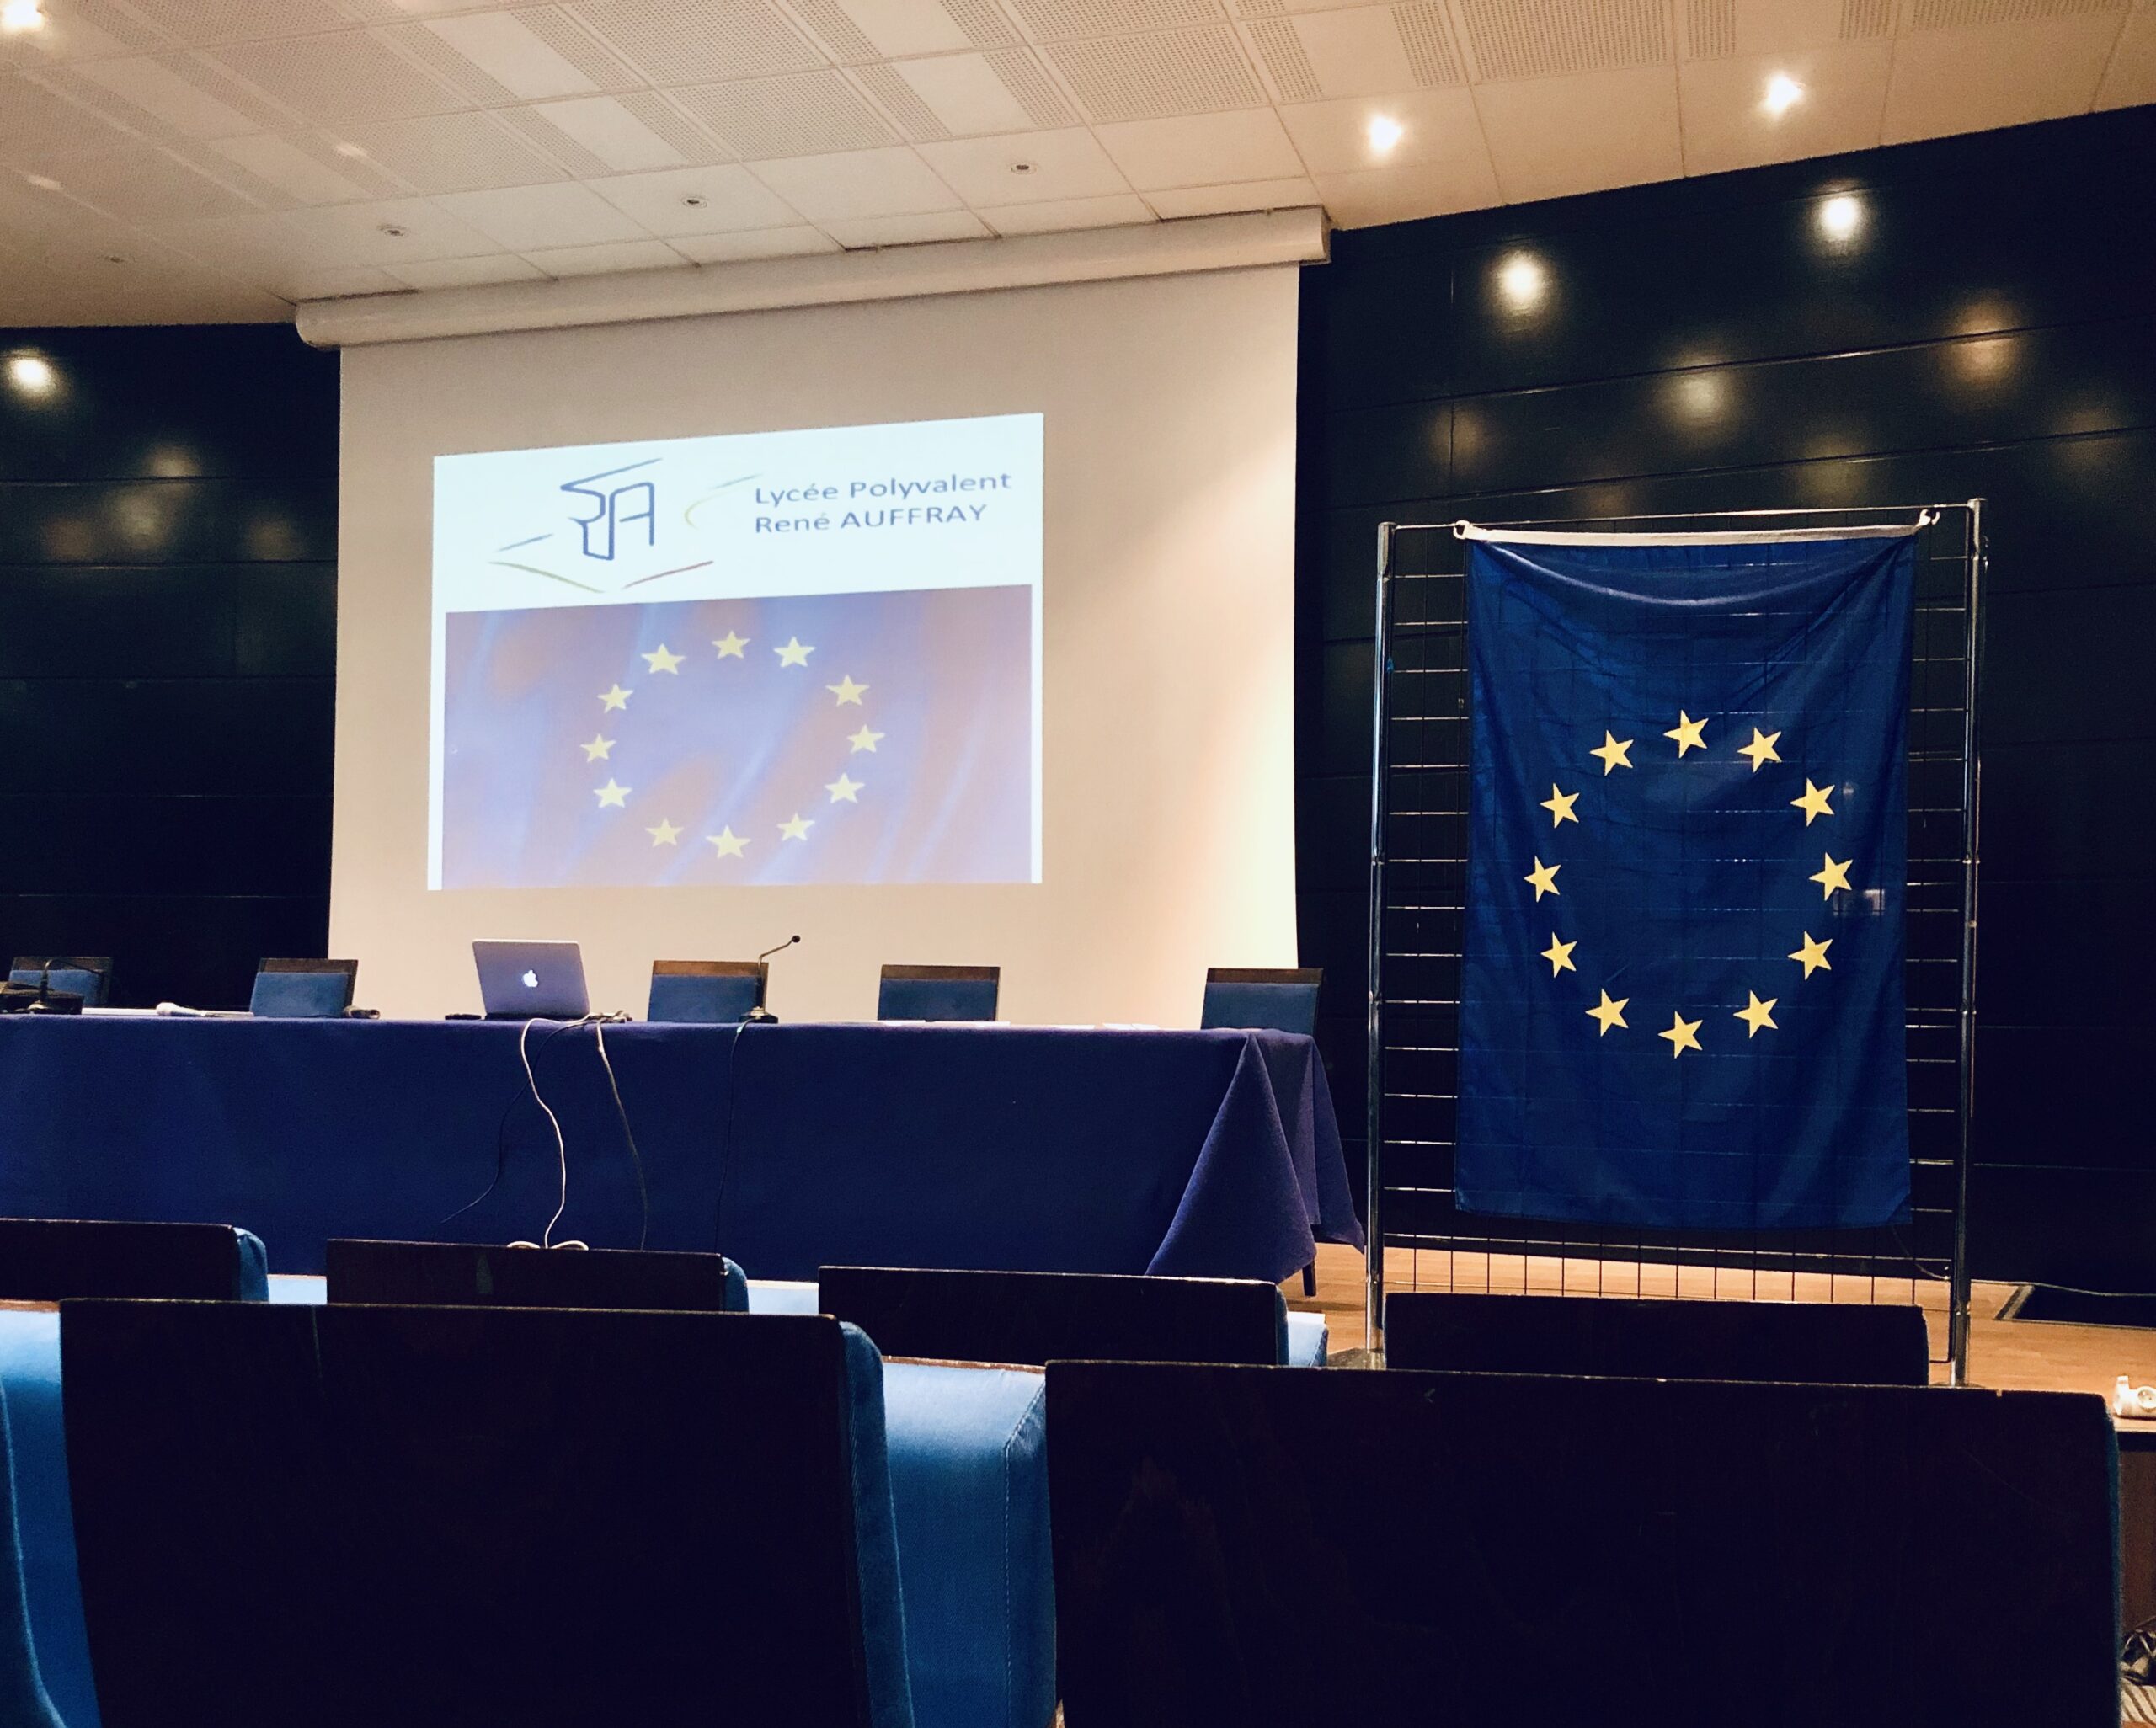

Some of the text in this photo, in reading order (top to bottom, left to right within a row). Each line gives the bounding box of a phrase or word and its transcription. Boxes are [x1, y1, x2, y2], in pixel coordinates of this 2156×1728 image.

[755, 473, 1012, 507] Lycée Polyvalent
[755, 504, 988, 533] René AUFFRAY
